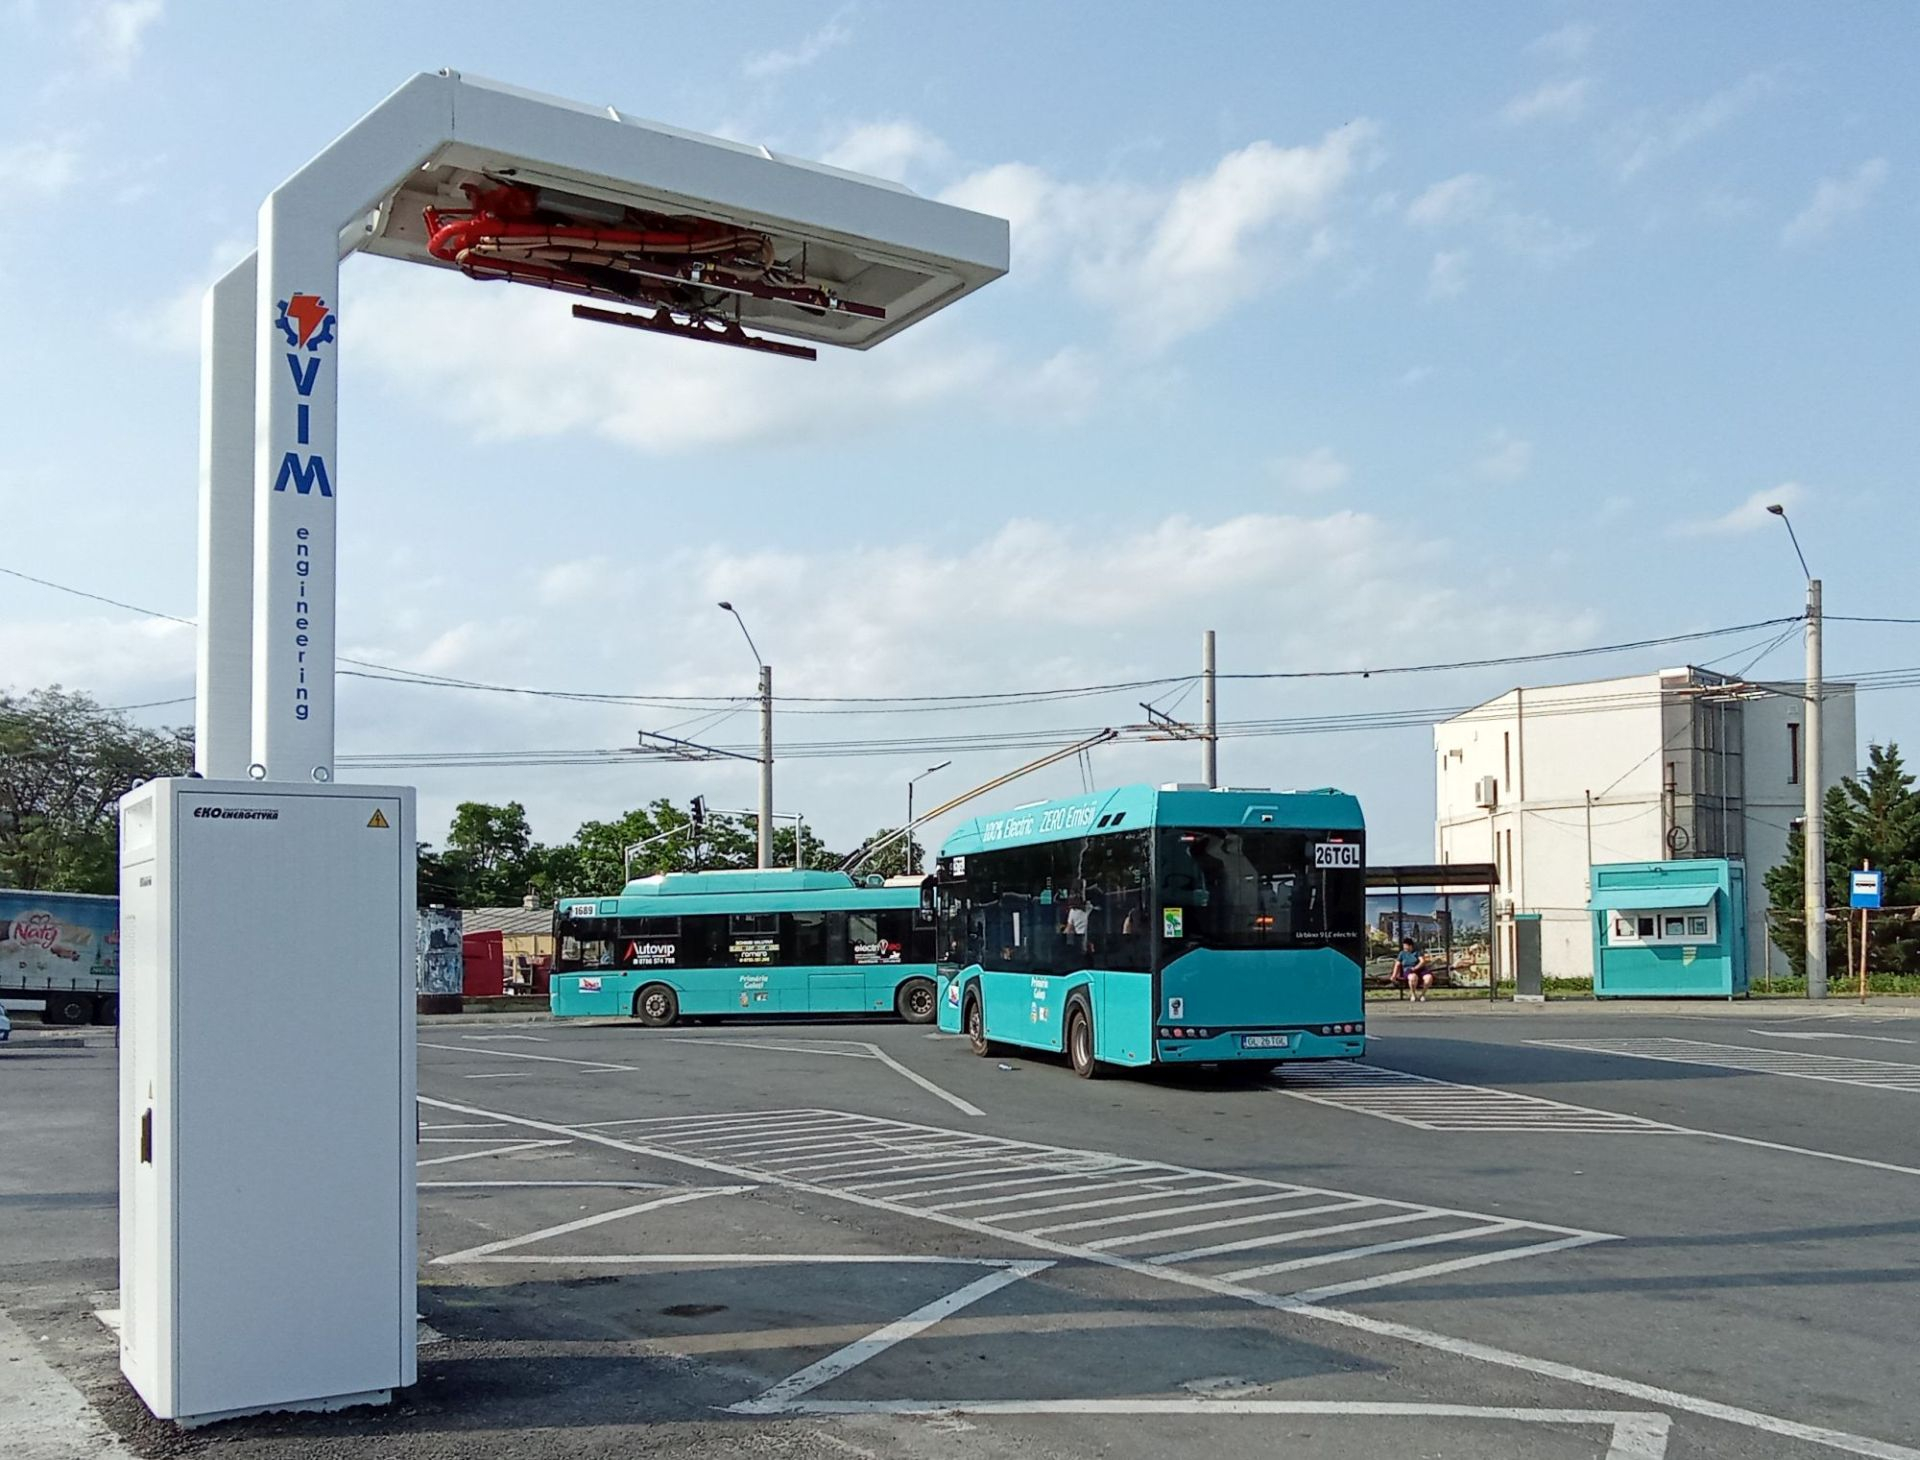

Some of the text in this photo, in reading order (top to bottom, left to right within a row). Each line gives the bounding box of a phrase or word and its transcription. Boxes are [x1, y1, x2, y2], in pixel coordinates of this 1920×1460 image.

[273, 353, 333, 498] VIM
[295, 527, 310, 721] engineering
[1003, 815, 1034, 839] Electric
[1039, 807, 1066, 833] ZERO
[1316, 846, 1359, 865] 26TGL
[574, 906, 594, 915] 1689
[14, 922, 58, 949] Naty
[624, 939, 675, 960] Autovip
